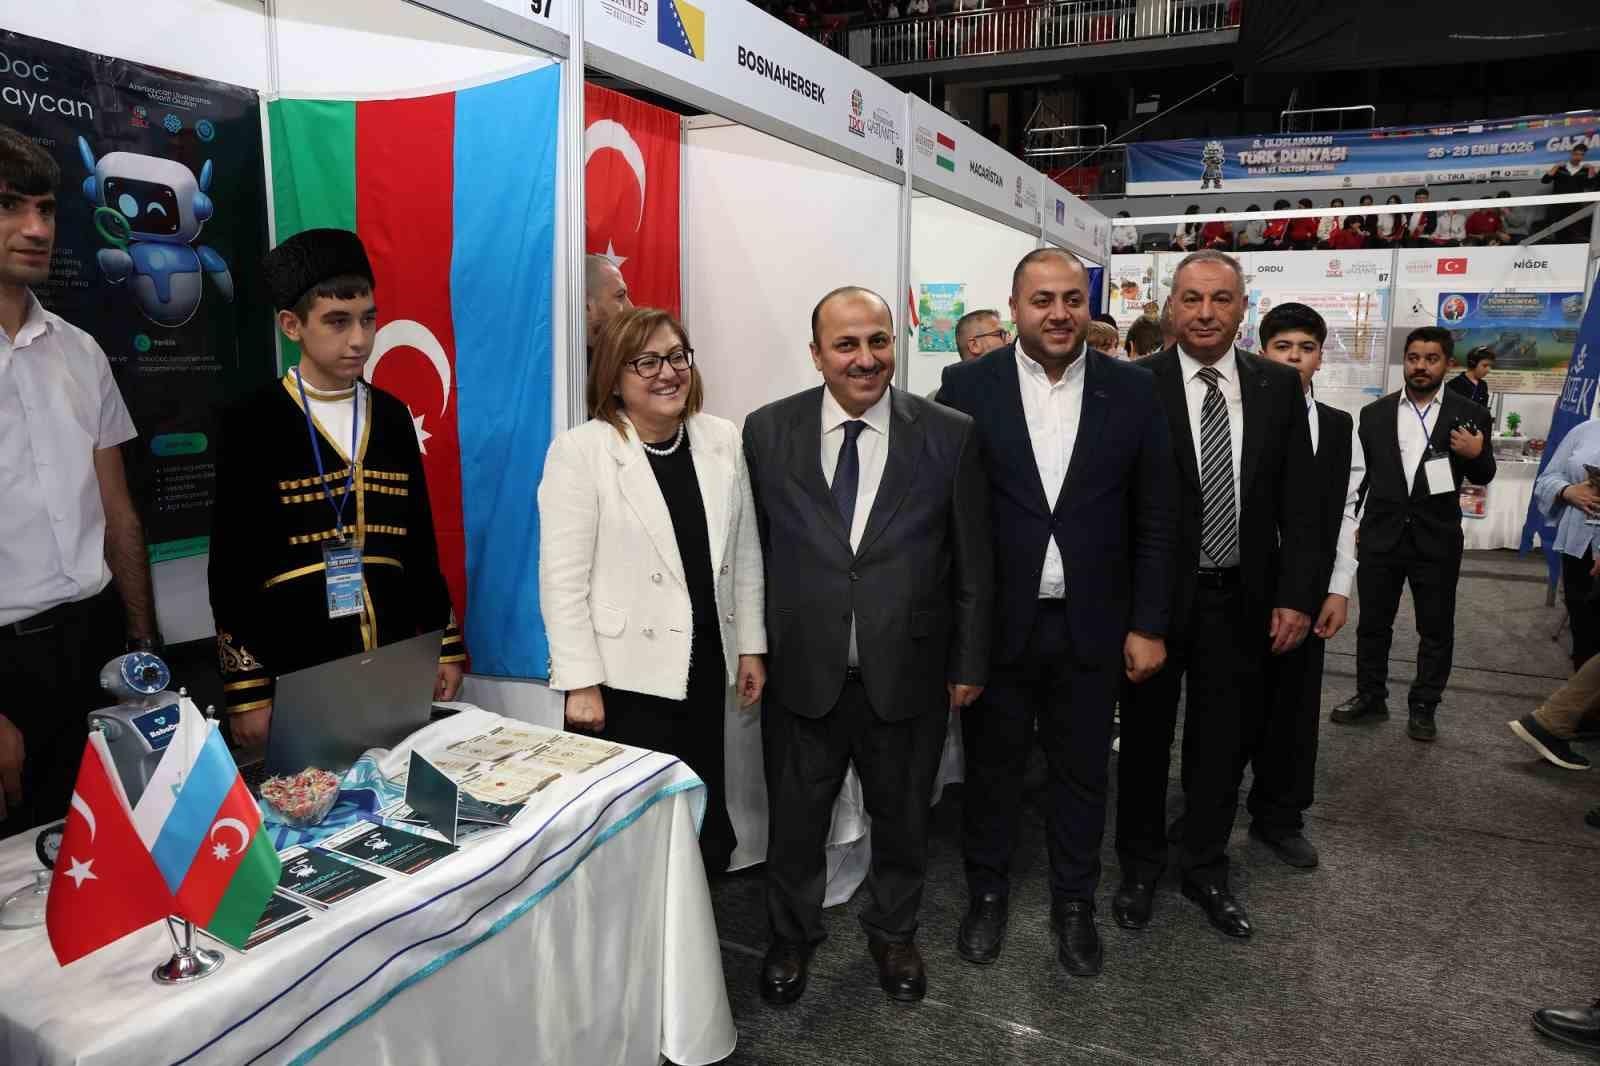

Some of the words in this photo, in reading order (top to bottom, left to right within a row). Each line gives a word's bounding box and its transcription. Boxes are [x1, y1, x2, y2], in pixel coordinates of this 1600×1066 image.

[737, 45, 825, 105] BOSNAHERSEK
[2, 86, 93, 120] aycan
[1257, 265, 1284, 273] ORDU
[1513, 258, 1549, 269] NİĞDE
